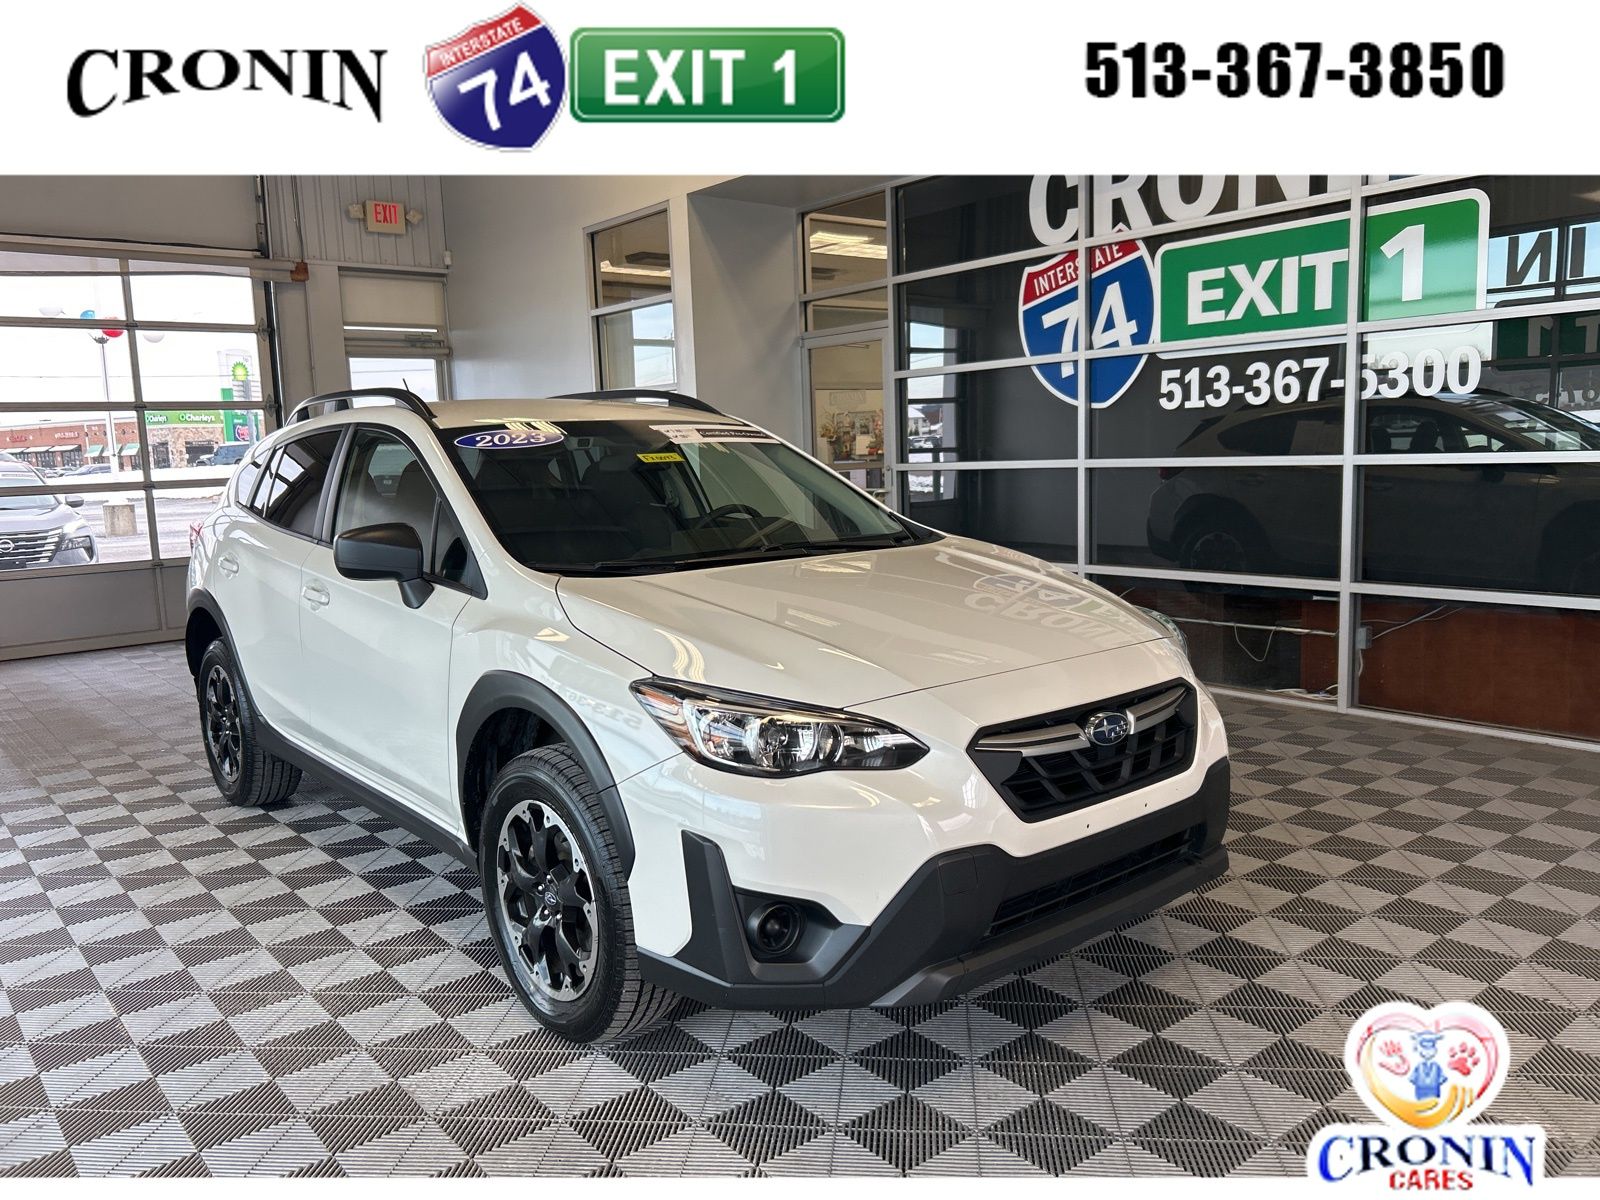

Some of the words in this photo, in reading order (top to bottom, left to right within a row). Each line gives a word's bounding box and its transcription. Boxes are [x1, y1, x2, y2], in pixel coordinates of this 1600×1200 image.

[374, 202, 399, 224] EXIT
[1034, 243, 1124, 296] INTERSATE
[1187, 248, 1349, 326] EXIT
[1380, 224, 1425, 302] 1
[1042, 281, 1138, 379] 74
[1159, 346, 1482, 410] 513-367-5300
[475, 432, 546, 447] 2023
